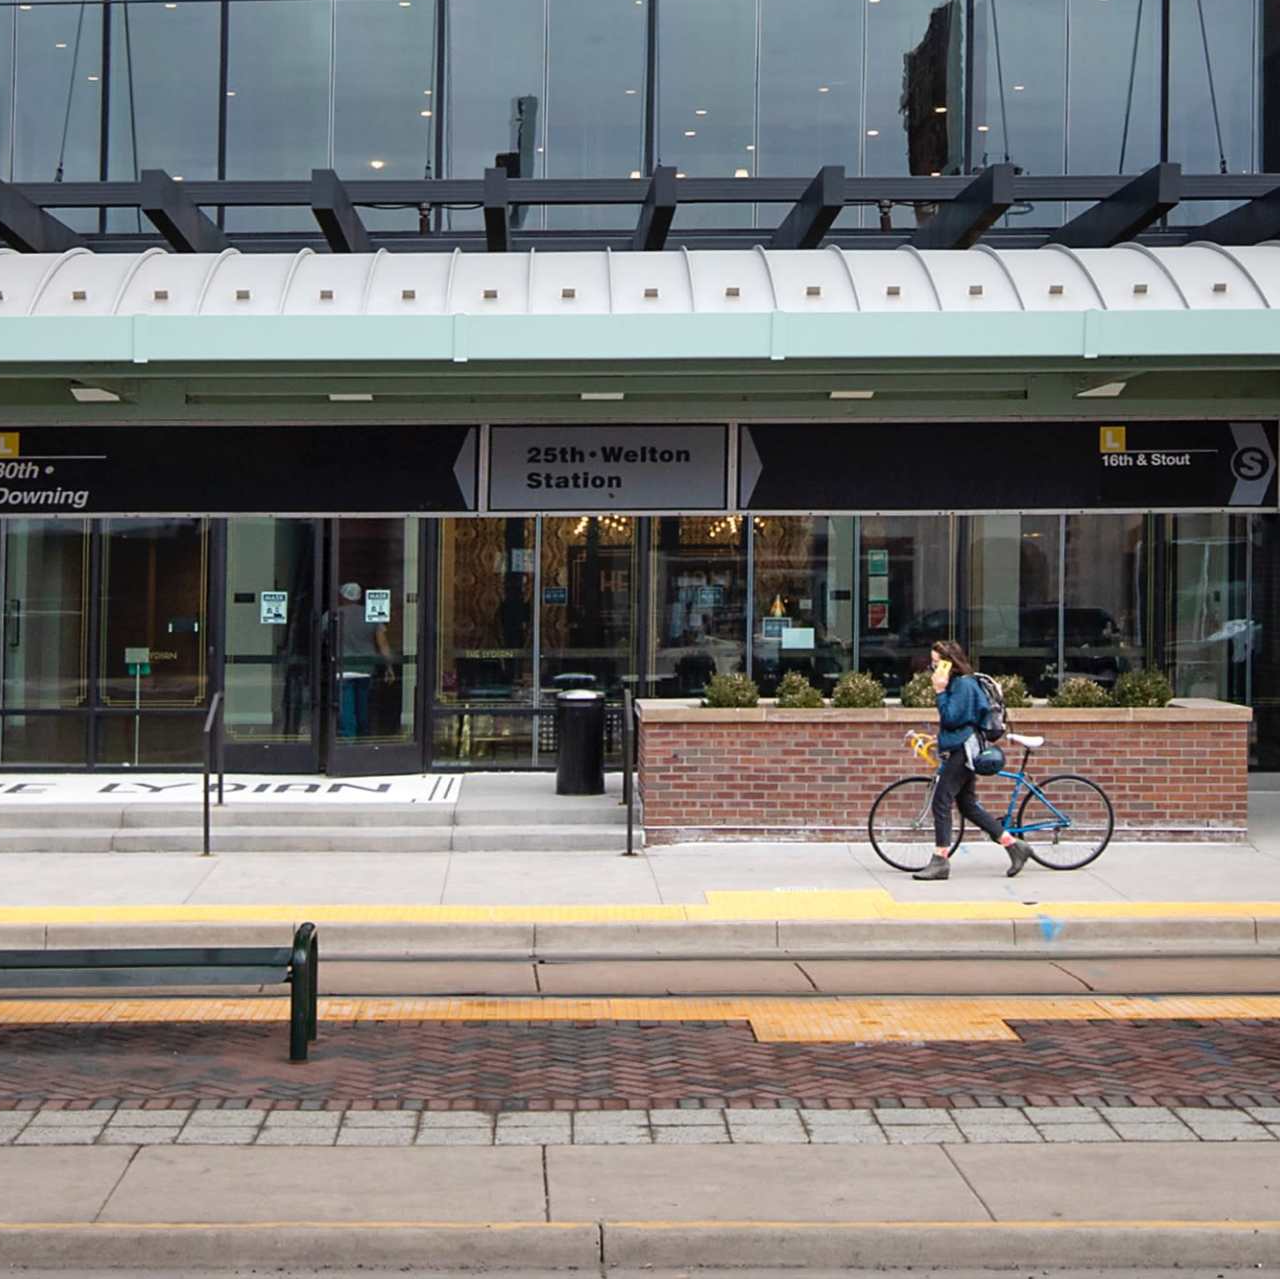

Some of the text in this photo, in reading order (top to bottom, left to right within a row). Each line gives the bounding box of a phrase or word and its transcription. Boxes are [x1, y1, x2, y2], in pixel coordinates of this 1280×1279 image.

[0, 436, 12, 453] L
[1106, 431, 1120, 448] L
[1102, 453, 1191, 467] 16th & Stout
[1239, 451, 1263, 477] S
[527, 472, 622, 488] Station
[98, 782, 392, 793] LYDIAN
